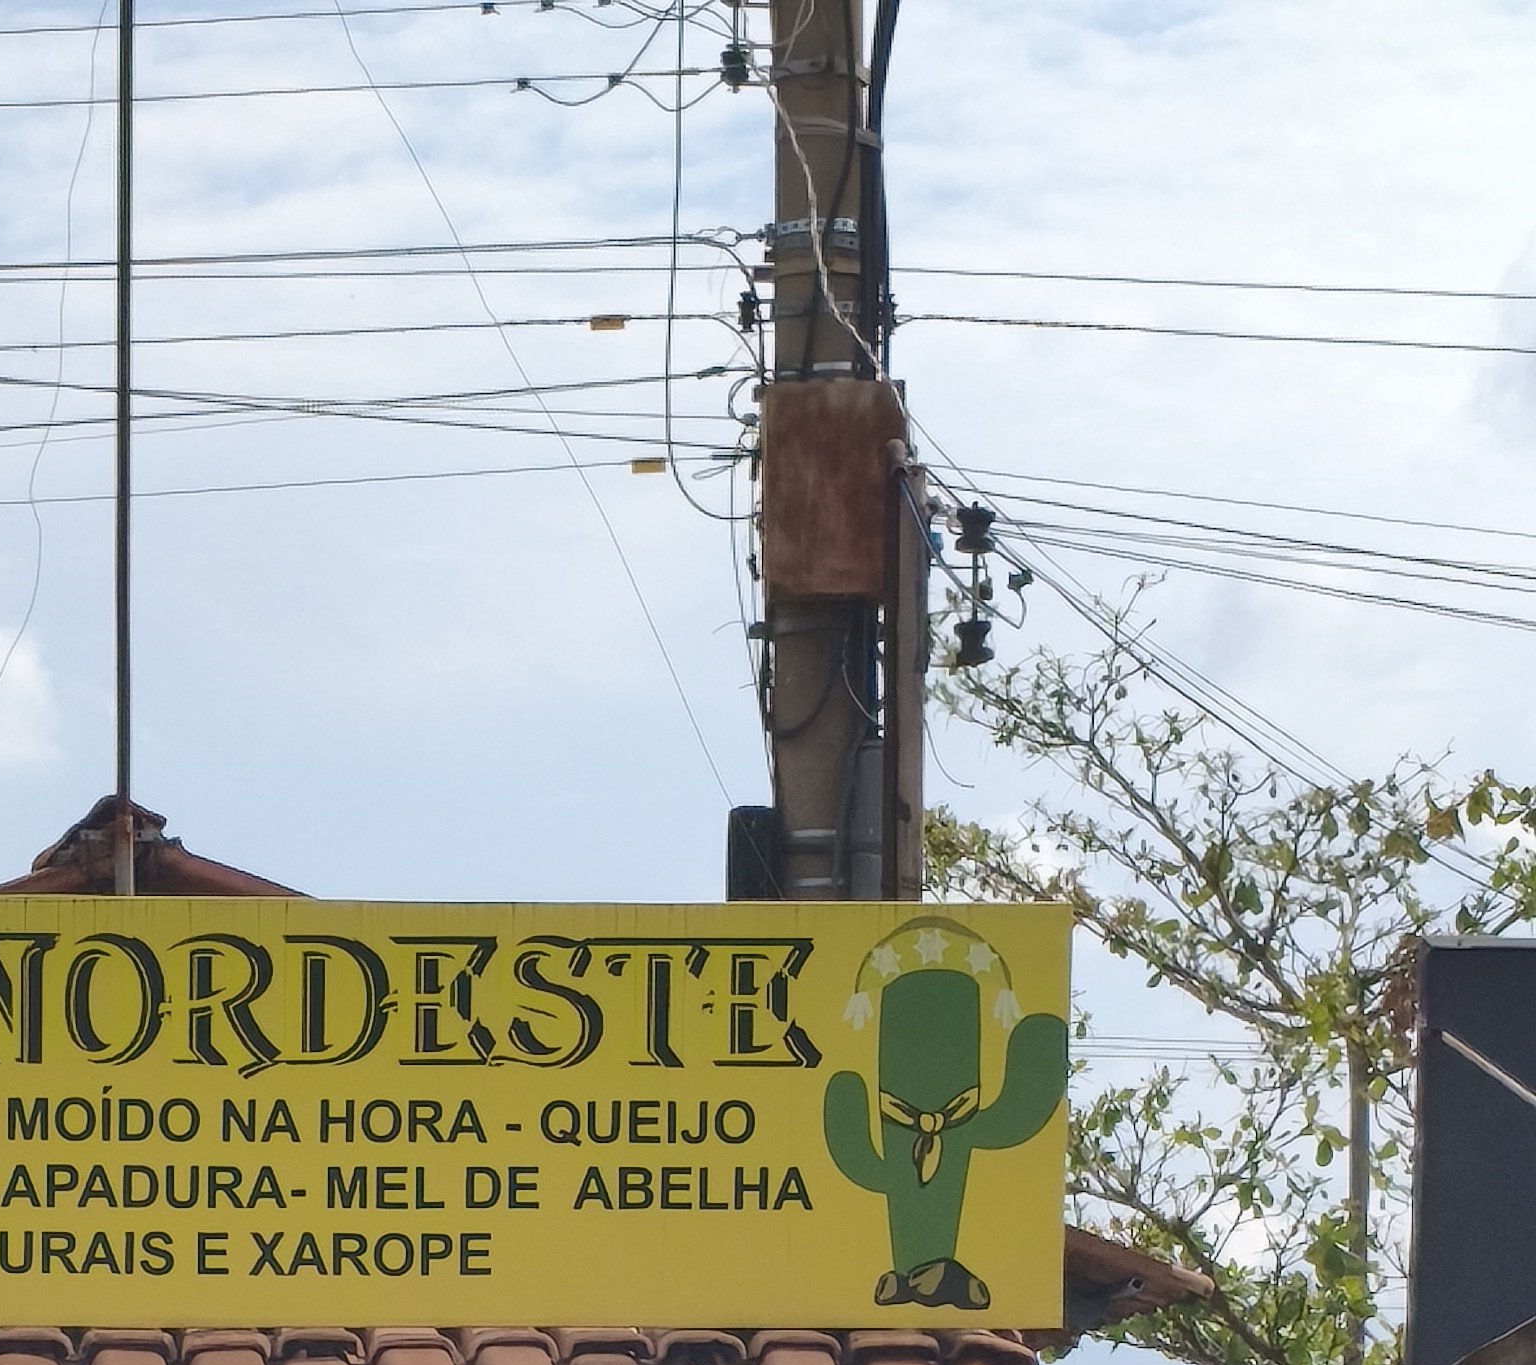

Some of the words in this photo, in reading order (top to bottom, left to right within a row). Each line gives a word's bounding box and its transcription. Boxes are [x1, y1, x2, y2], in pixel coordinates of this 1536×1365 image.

[7, 1085, 201, 1143] MOÍDO
[222, 1098, 302, 1143] NA
[319, 1098, 488, 1144] HORA
[540, 1099, 756, 1147] QUEIJO
[327, 1166, 445, 1210] MEL
[465, 1166, 540, 1210] DE
[573, 1165, 814, 1211] ABELHA
[197, 1231, 230, 1275] E
[248, 1231, 492, 1277] XAROPE
